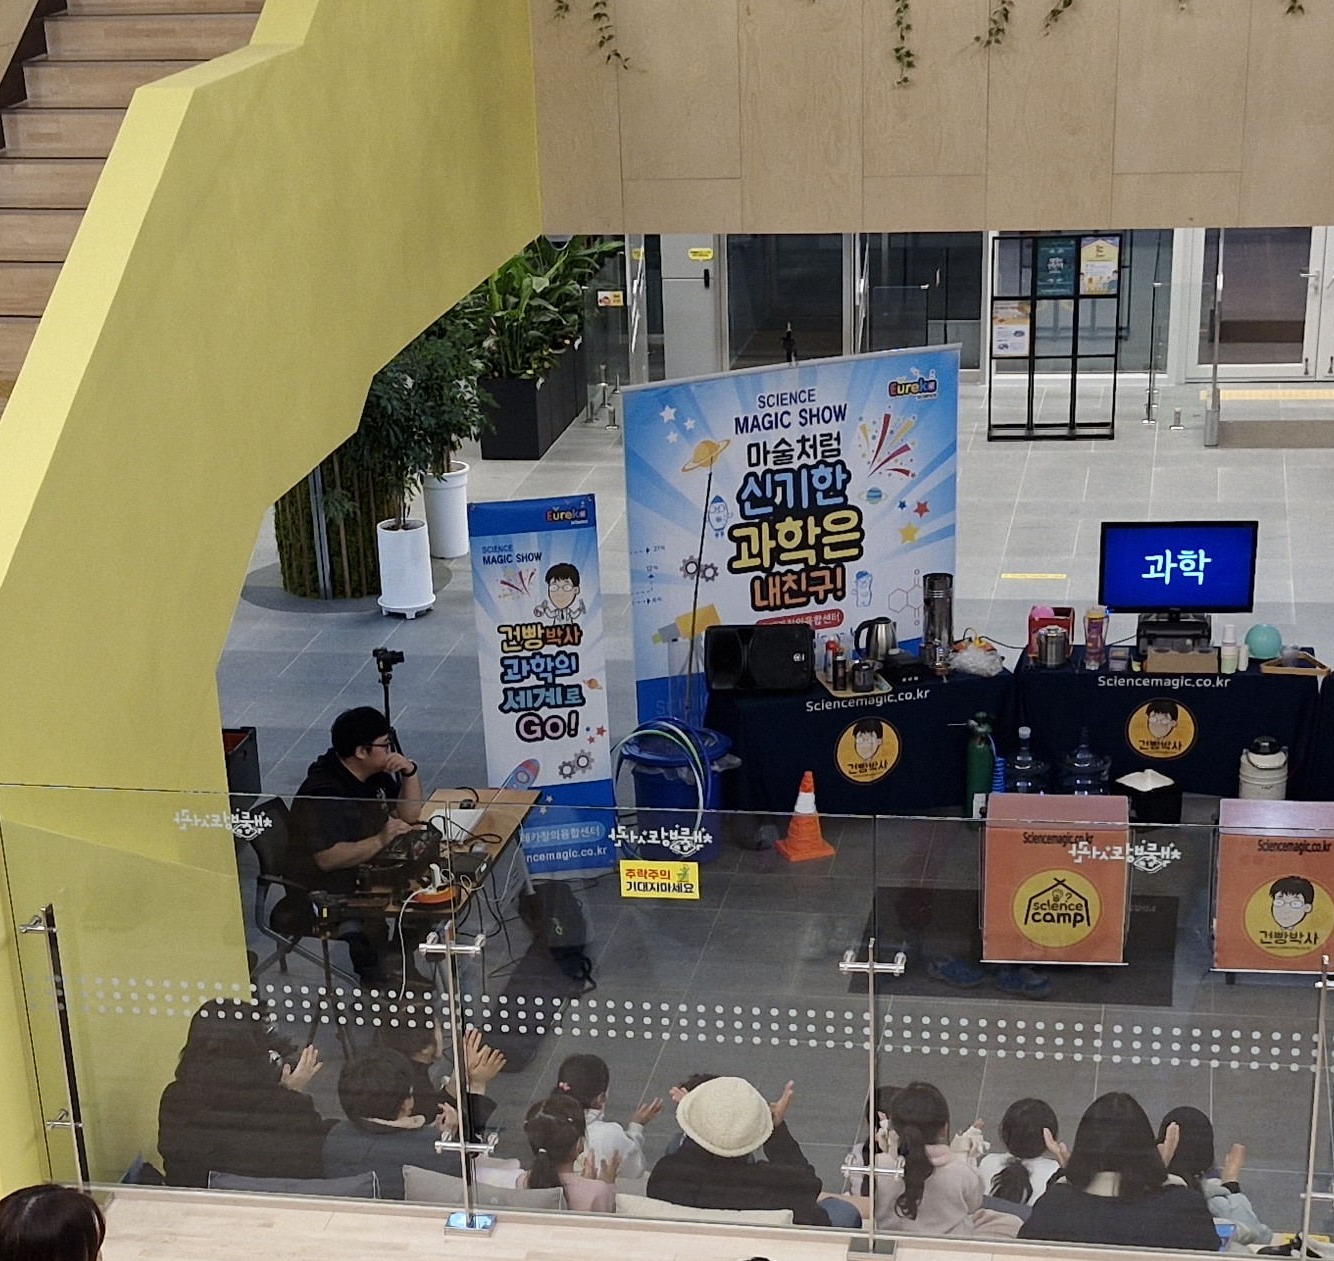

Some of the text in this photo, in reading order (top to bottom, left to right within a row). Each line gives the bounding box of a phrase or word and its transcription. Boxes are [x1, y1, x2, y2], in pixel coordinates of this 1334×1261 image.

[758, 388, 816, 409] SCIENCE
[735, 404, 847, 435] MAGIC SHOW
[747, 431, 841, 467] 마술처럼
[739, 462, 850, 517] 신기한
[482, 543, 513, 554] SCIENCE
[730, 508, 863, 571] 과학은
[483, 552, 542, 565] MAGIC SHOW
[1142, 549, 1211, 586] 과학
[752, 566, 845, 609] 내친구!
[498, 624, 582, 652] 건빵박사
[501, 653, 578, 683] 과학의
[1097, 675, 1231, 689] Sciencemagic.co.kr
[499, 685, 585, 713] 세계로
[806, 688, 930, 713] Sciencemagic.co.kr
[1258, 839, 1331, 855] Sciencemagic.co.kr
[625, 868, 671, 880] 추락주의
[626, 882, 694, 894] 기대지마세요
[1033, 899, 1083, 911] science
[1031, 911, 1084, 928] camp
[1259, 930, 1319, 945] 건빵박사
